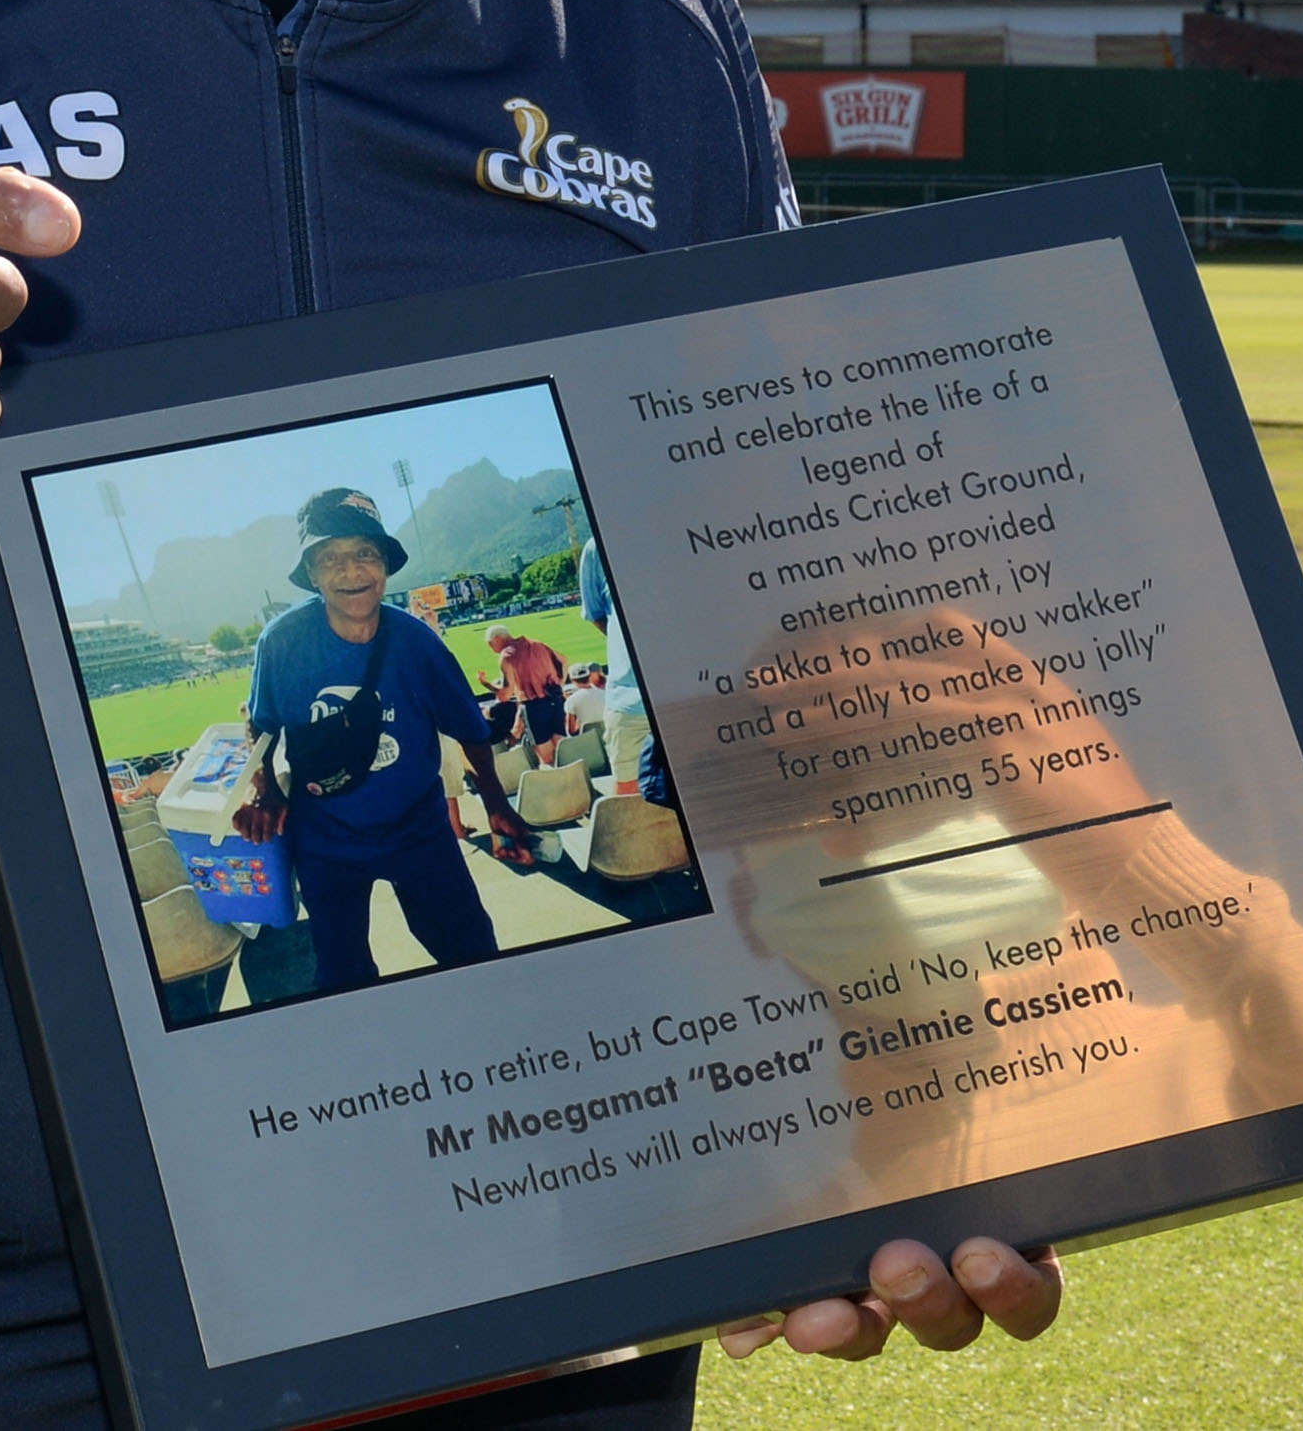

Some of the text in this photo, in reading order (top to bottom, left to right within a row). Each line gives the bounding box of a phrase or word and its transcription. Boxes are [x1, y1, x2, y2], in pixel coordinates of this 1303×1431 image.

[832, 89, 912, 107] SIX GUN
[836, 106, 909, 128] GRILL
[487, 151, 657, 229] Cobras
[546, 134, 653, 188] Cape
[628, 325, 1054, 422] This serves to commemorate
[667, 368, 1050, 464] and celebrate the life of a
[686, 451, 1085, 555] Newlands Cricket Ground,
[800, 429, 944, 487] legend of
[747, 502, 1056, 592] a man who provided
[698, 577, 1153, 696] "a sakka to make you wakker"
[780, 558, 1051, 633] entertainment, joy
[717, 622, 1166, 744] and a "lolly to make you jolly"
[777, 684, 1142, 780] for an unbeaten innings
[831, 741, 1120, 825] spanning 55 years.
[248, 875, 1253, 1139] He wanted to retire, but Cape Town said 'No, keep the change.'
[425, 978, 1134, 1159] Mr Moegamat "Boeta" Gielmie Cassiem,
[451, 1035, 1140, 1213] Newlands will always love and cherish you.
